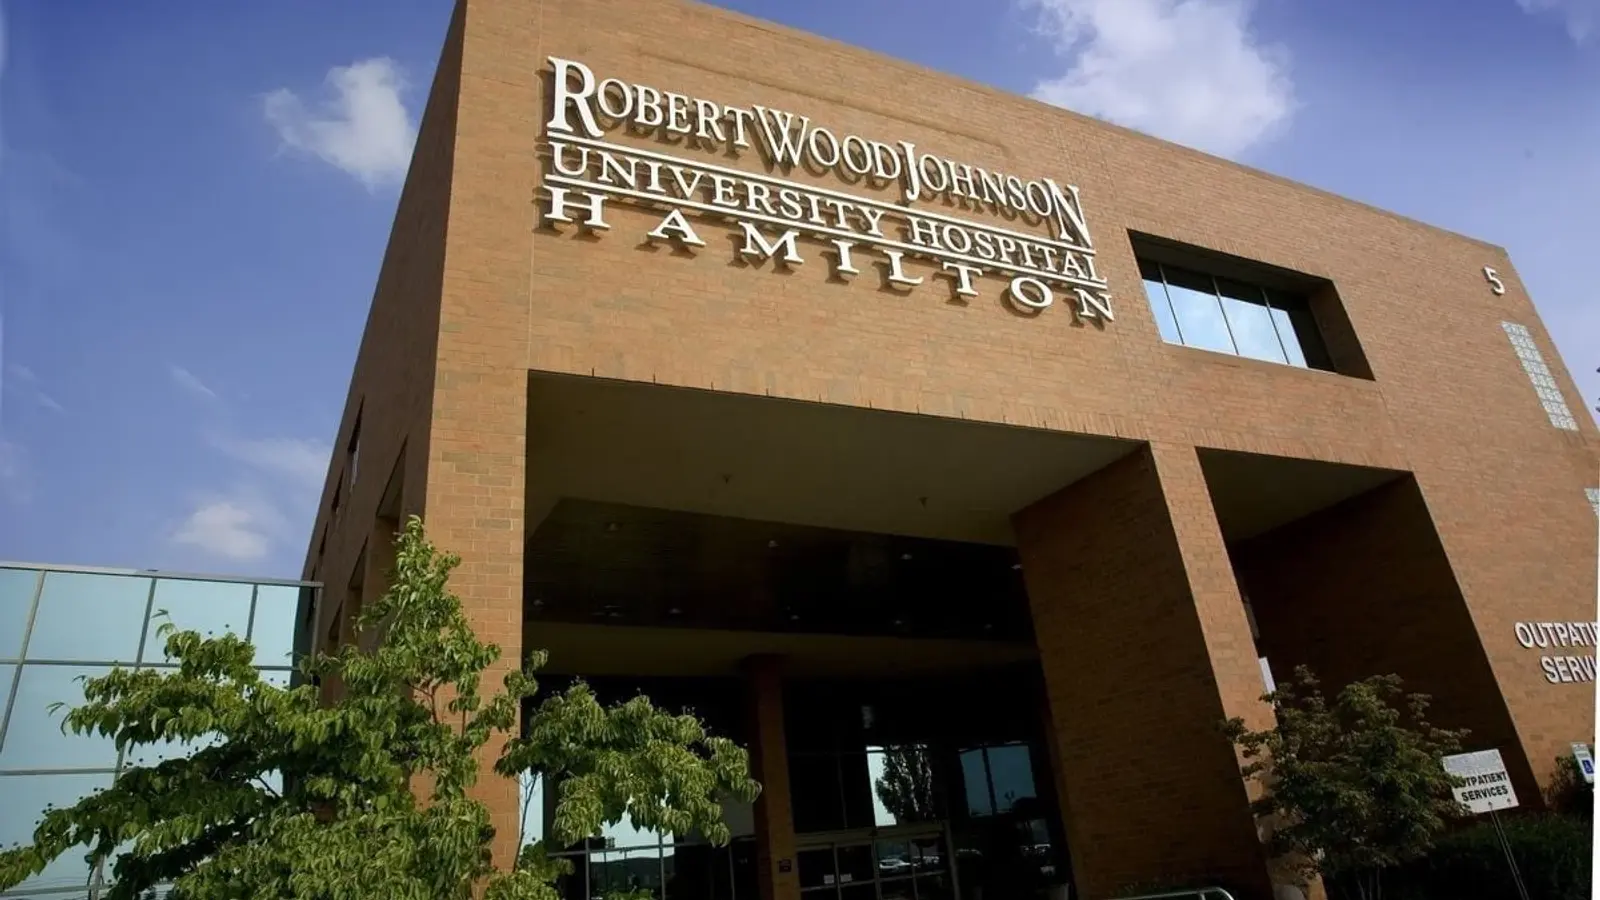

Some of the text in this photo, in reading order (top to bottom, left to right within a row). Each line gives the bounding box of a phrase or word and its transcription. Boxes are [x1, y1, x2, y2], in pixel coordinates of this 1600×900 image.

[546, 56, 1093, 248] ROBERT WOOD JOHNSON
[542, 185, 1115, 322] HAMILTON
[547, 141, 1108, 283] UNIVERSITY HOSPITAL
[1482, 265, 1506, 295] 5
[1461, 784, 1509, 802] SERVICES
[1462, 771, 1508, 787] TPATIENT
